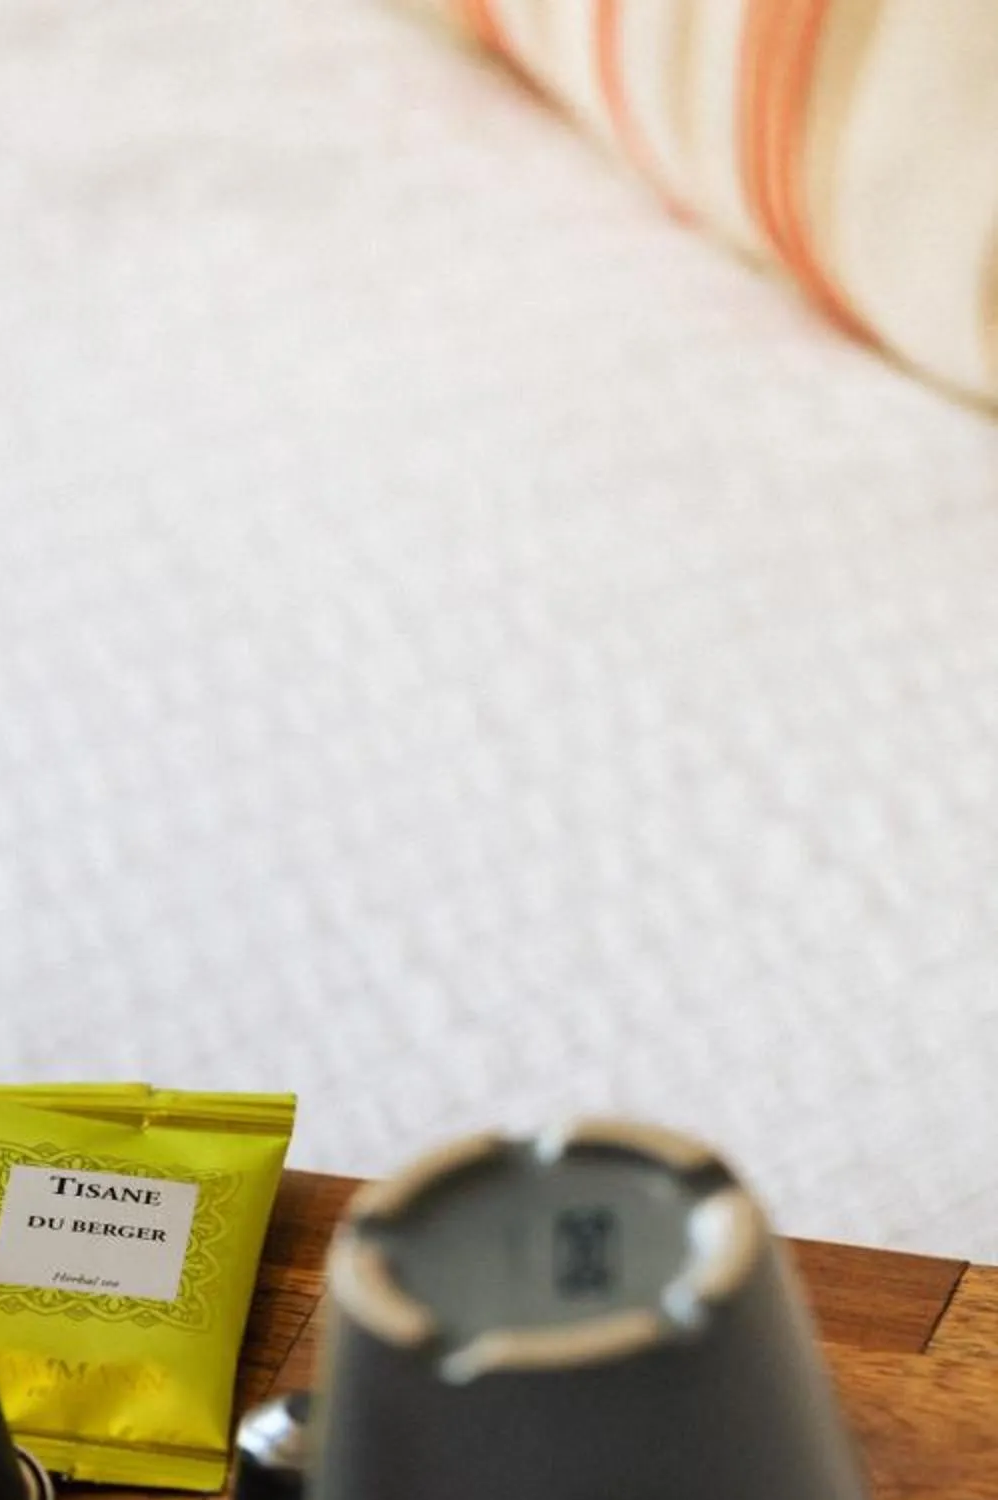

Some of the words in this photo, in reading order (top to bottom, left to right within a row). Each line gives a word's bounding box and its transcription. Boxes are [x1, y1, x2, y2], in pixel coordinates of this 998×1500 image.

[50, 1175, 162, 1207] TISANE
[27, 1215, 65, 1231] DU
[71, 1219, 167, 1242] BERGER
